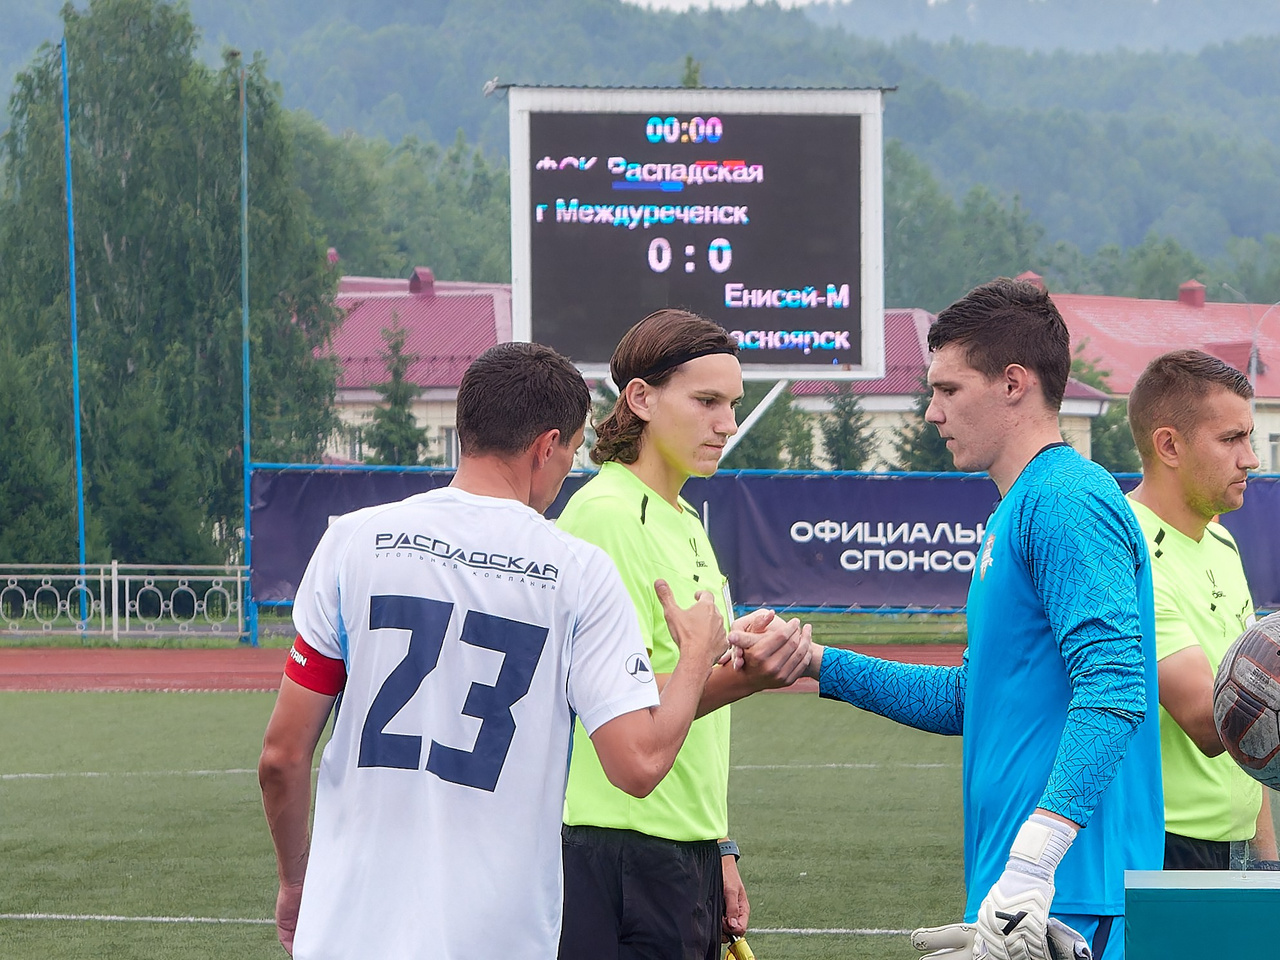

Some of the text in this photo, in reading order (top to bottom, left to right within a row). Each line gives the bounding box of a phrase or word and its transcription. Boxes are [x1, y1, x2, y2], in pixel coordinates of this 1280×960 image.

[646, 116, 723, 143] 00:00
[607, 156, 764, 185] Распадская
[536, 198, 750, 230] г Междуреченск
[725, 283, 850, 309] Енисей-М
[730, 330, 851, 355] асноярск
[375, 532, 559, 581] РАСПАДСКАЯ
[840, 550, 976, 572] СПОНСО
[375, 552, 556, 591] УГОЛЬНАЯ КОМПАНИЯ
[357, 594, 550, 793] 23
